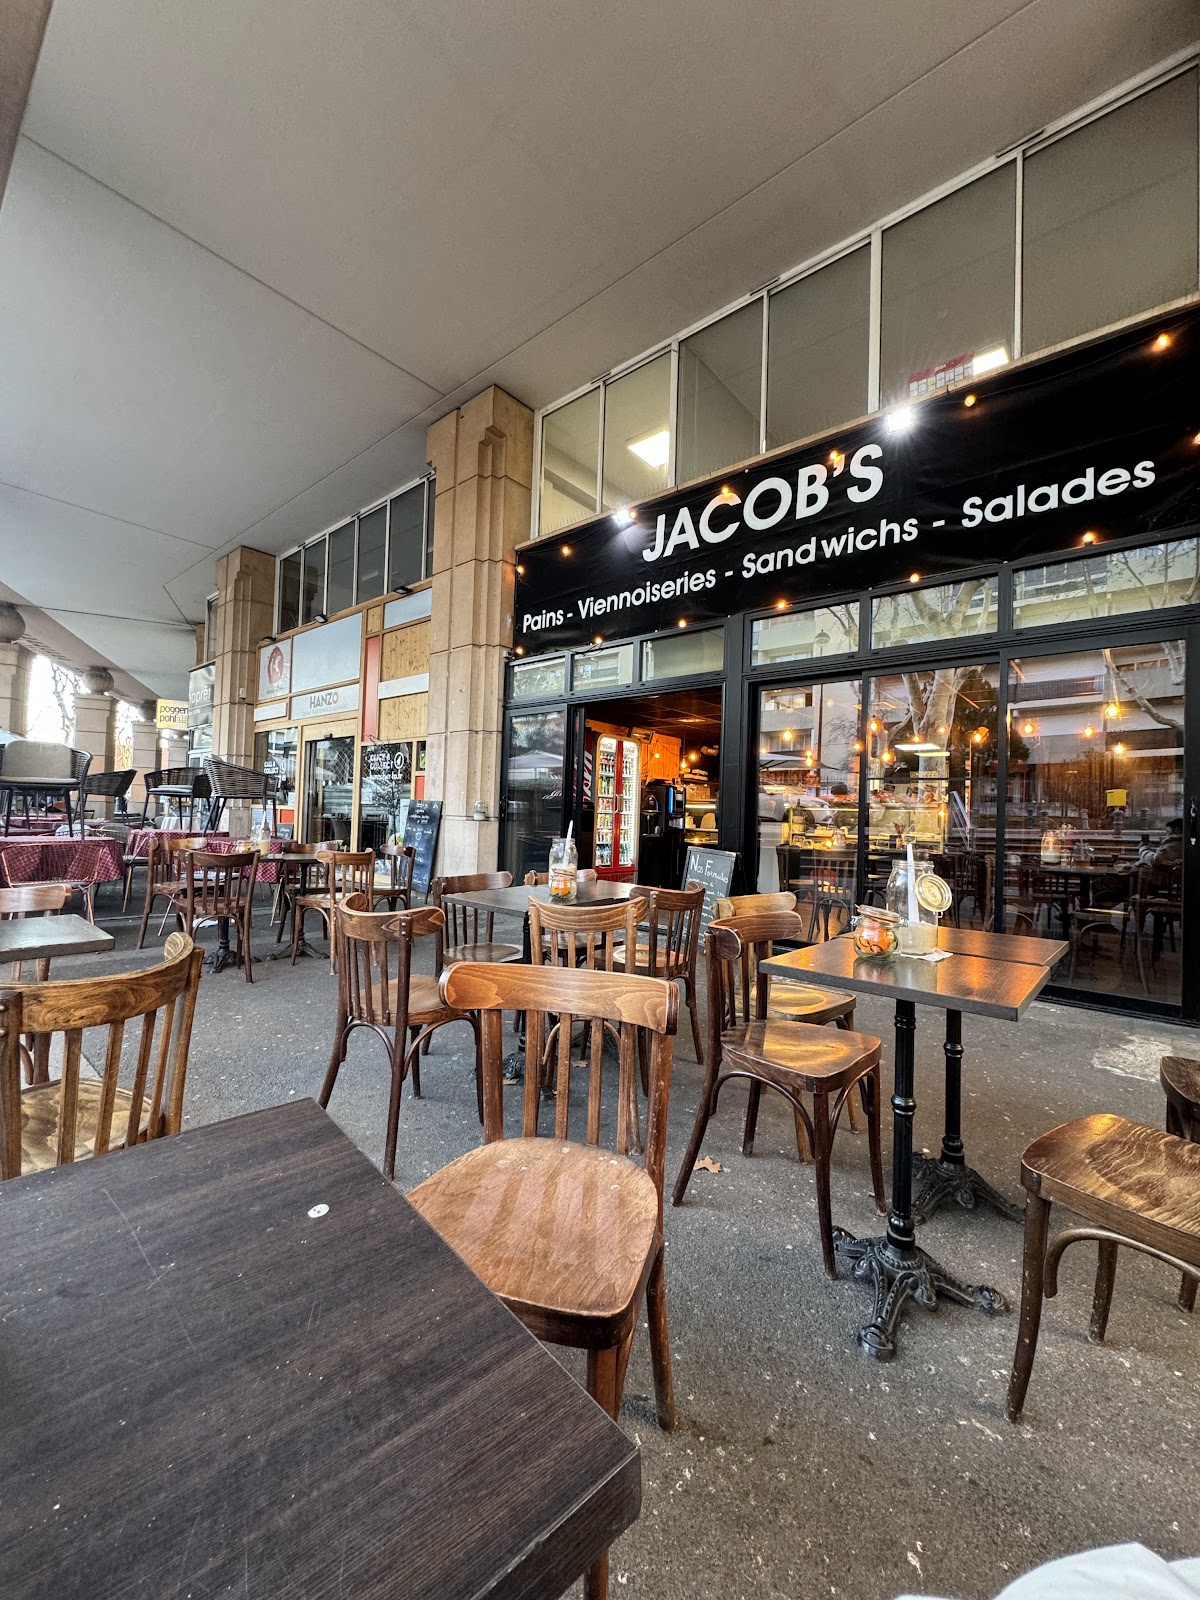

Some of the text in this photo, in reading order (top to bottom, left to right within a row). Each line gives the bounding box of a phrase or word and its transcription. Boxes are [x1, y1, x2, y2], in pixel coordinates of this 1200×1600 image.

[643, 444, 884, 562] JACOB'S
[578, 568, 717, 620] Viennoiseries
[742, 517, 919, 580] Sandwichs
[961, 460, 1156, 528] Salades
[160, 705, 188, 715] poggen
[310, 691, 339, 709] HANZO
[160, 715, 176, 723] pohl
[690, 855, 703, 873] Nos
[705, 860, 729, 884] Formules
